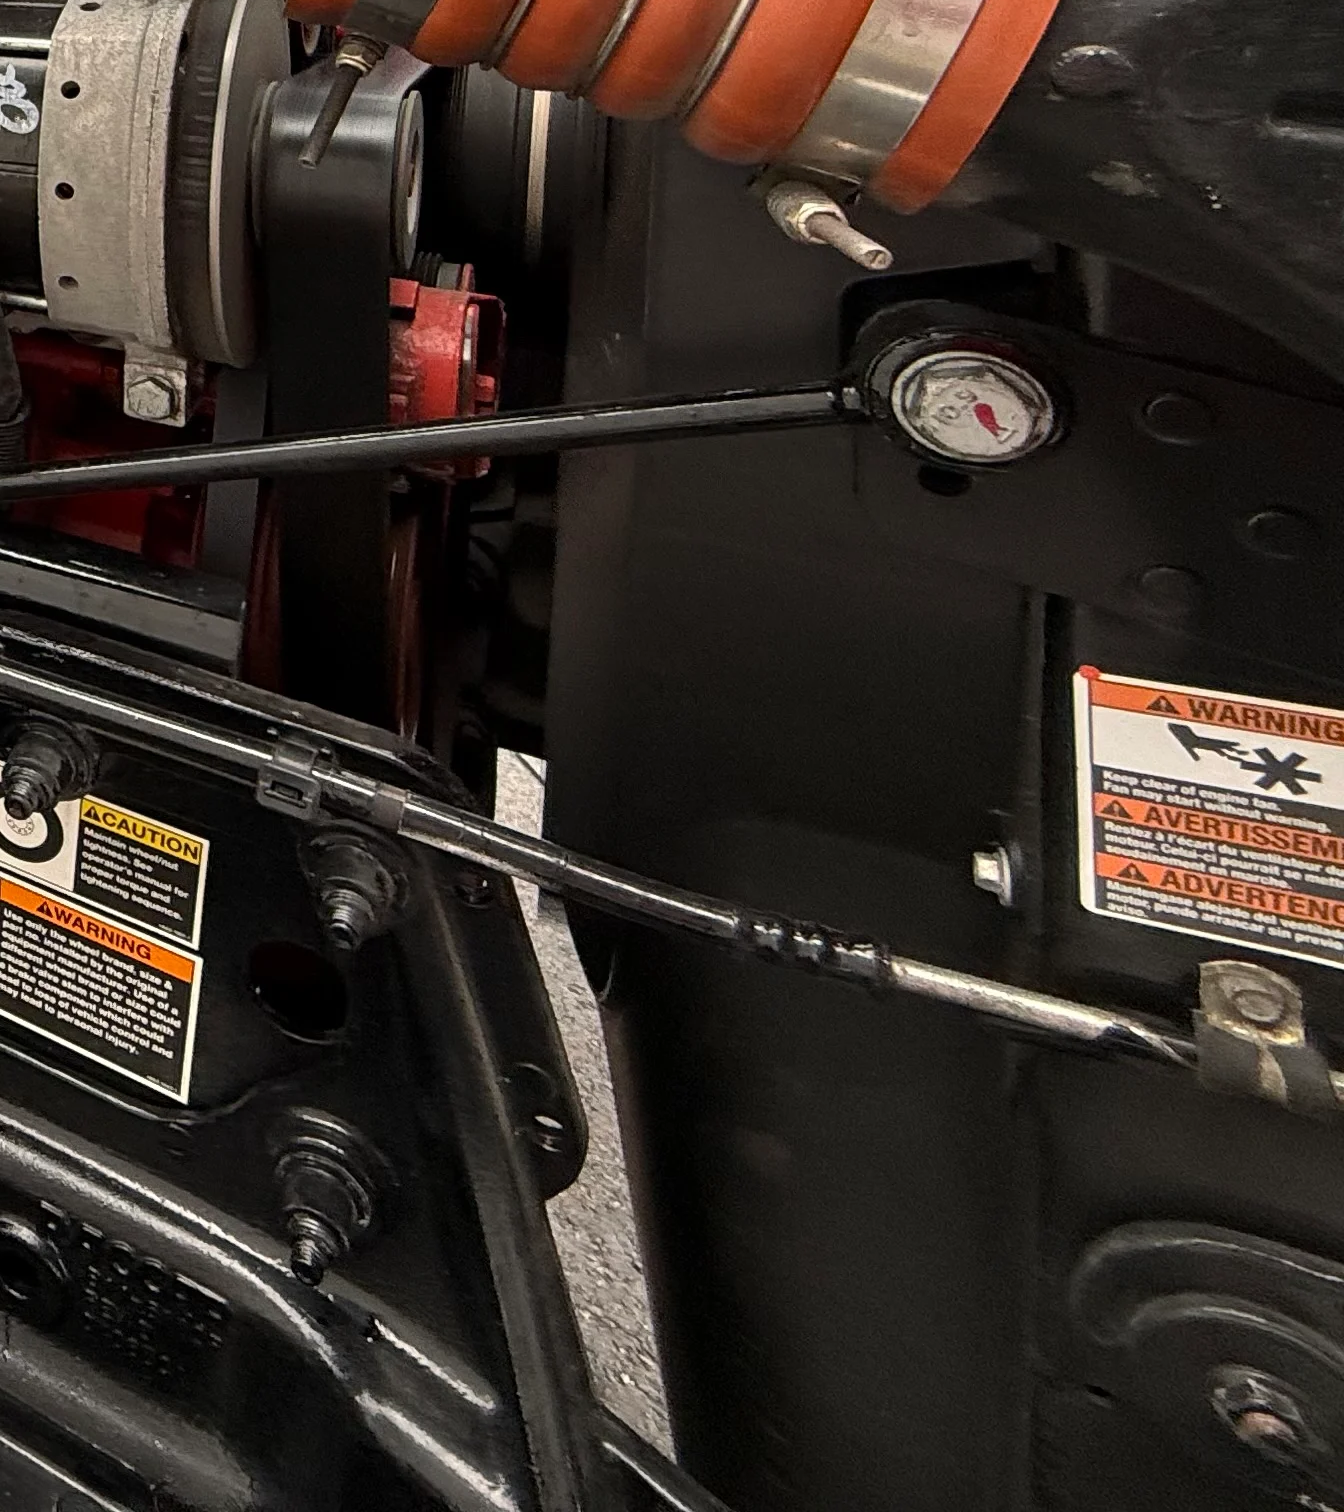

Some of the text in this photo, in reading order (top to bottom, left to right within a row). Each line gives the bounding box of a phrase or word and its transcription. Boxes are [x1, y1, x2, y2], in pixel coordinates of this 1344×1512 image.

[1103, 771, 1249, 807] Keep clear of engine
[1104, 782, 1129, 796] Fan
[1133, 787, 1163, 802] may
[1167, 793, 1201, 809] start
[1204, 800, 1261, 820] without
[84, 826, 127, 851] Maintain
[102, 810, 198, 861] CAUTION
[1105, 821, 1152, 839] Restez
[1155, 831, 1164, 842] à
[1219, 843, 1238, 856] du
[1143, 806, 1344, 860] AVERTISSEM
[80, 871, 130, 902] tightening
[81, 861, 171, 905] proper torque and
[133, 858, 153, 874] See
[135, 870, 189, 900] manual for
[1209, 865, 1227, 877] en
[1284, 868, 1302, 881] se
[53, 907, 151, 961] WARNING
[1154, 902, 1198, 920] puede
[1268, 926, 1292, 941] sin
[3, 908, 24, 925] Use
[25, 918, 48, 936] only
[50, 929, 67, 944] the
[69, 937, 100, 959] wheel
[139, 969, 162, 987] size
[3, 919, 23, 935] part
[44, 937, 88, 964] installed
[90, 958, 104, 971] by
[106, 965, 123, 980] the
[126, 974, 168, 1000] original
[0, 950, 174, 1038] cause valve stem to interfere with
[1, 939, 181, 1029] different wheel brand or size could
[2, 929, 55, 961] equipment
[133, 989, 155, 1006] Use
[157, 1000, 169, 1013] of
[171, 1006, 179, 1018] a
[0, 960, 165, 1045] a brake component which could
[21, 992, 43, 1010] lead
[44, 1003, 55, 1016] to
[57, 1009, 103, 1040] personal
[22, 981, 32, 993] to
[34, 987, 56, 1005] loss
[58, 999, 69, 1011] of
[72, 1005, 109, 1030] vehicle
[111, 1023, 150, 1049] control
[152, 1042, 174, 1060] and
